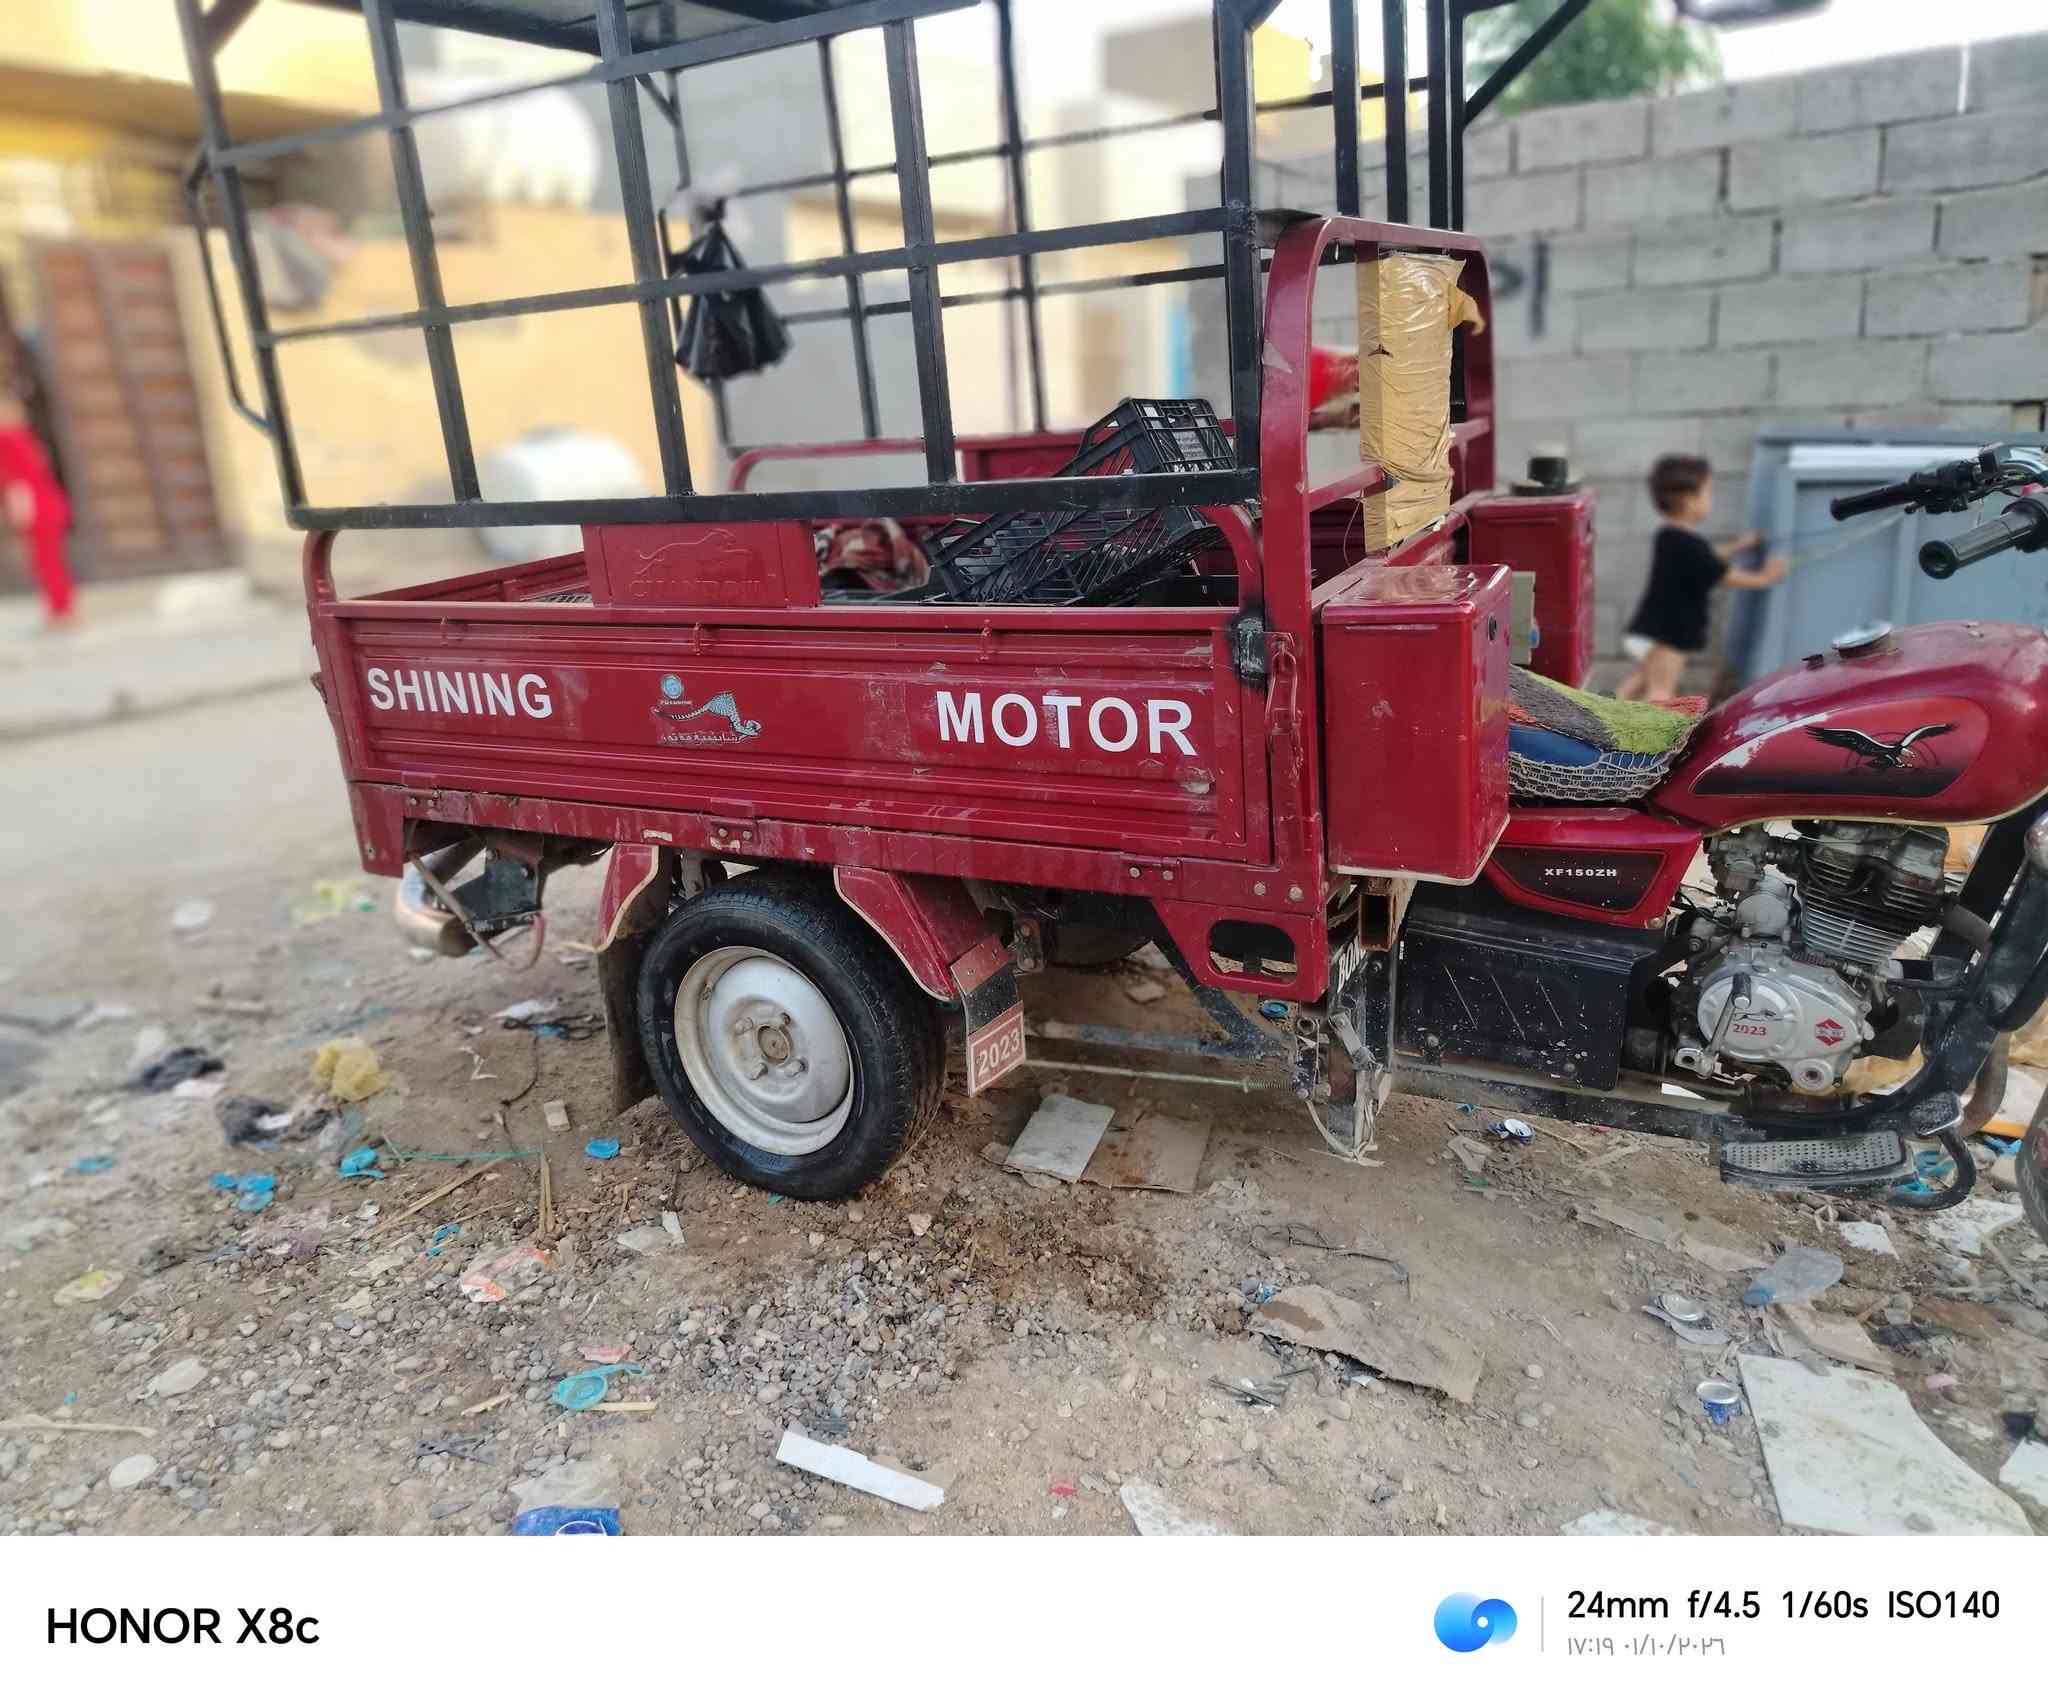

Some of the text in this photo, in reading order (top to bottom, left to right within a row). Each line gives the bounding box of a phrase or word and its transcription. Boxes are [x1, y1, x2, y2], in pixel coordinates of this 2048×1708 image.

[367, 667, 1198, 756] SHINING MOTOR
[1544, 867, 1618, 878] XF150ZH
[1732, 1023, 1767, 1036] 2023
[976, 1028, 1021, 1077] 2023
